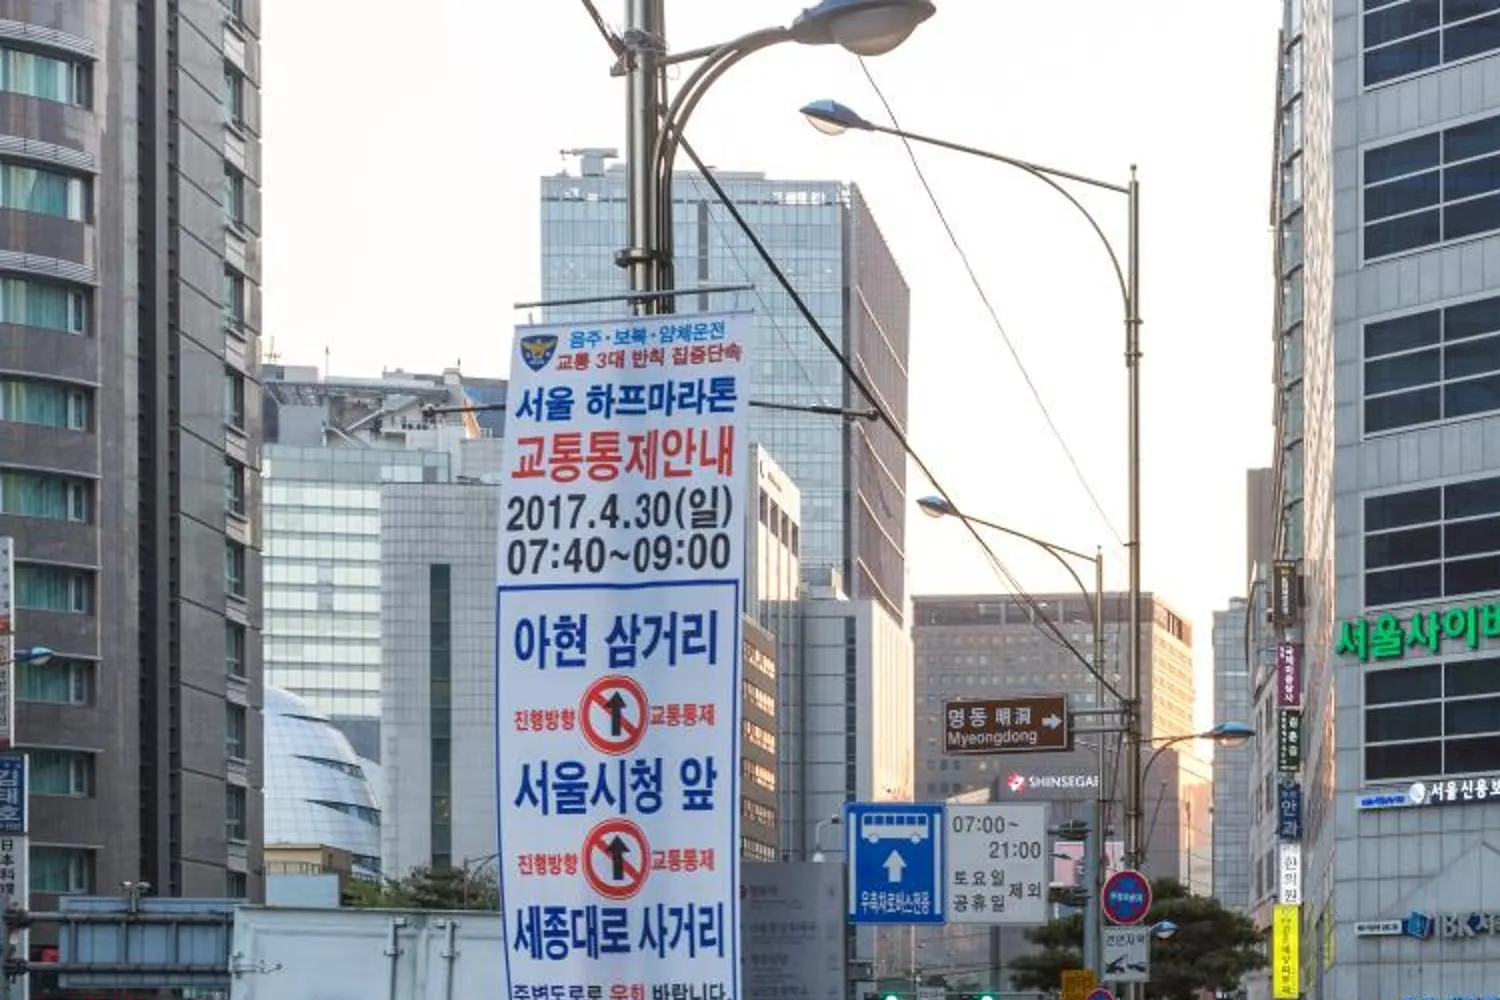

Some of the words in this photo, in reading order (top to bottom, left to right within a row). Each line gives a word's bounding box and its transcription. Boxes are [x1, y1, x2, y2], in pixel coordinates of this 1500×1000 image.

[556, 352, 589, 370] 교통
[595, 350, 625, 369] 3대
[515, 386, 575, 422] 서울
[586, 376, 737, 420] 하프마라톤
[511, 425, 735, 483] 교통통제안내
[506, 486, 733, 532] 2017.4.30(일)
[507, 533, 731, 575] 07:40~09:00
[514, 612, 588, 670] 아현
[605, 609, 719, 669] 삼거리
[514, 709, 576, 731] 진행방향
[650, 703, 715, 727] 교통통제
[948, 707, 988, 729] 명동
[948, 730, 1038, 747] Myeongdong
[514, 758, 664, 815] 서울시청
[680, 756, 718, 811] 앞
[952, 815, 1020, 834] 07:00~
[651, 848, 715, 873] 교통통제
[989, 842, 1042, 859] 21:00
[517, 853, 578, 876] 진행방향
[953, 869, 1005, 887] 토요일
[1009, 882, 1042, 899] 제외
[953, 894, 1006, 913] 공휴일
[514, 904, 631, 961] 세종대로
[638, 902, 724, 958] 사거리
